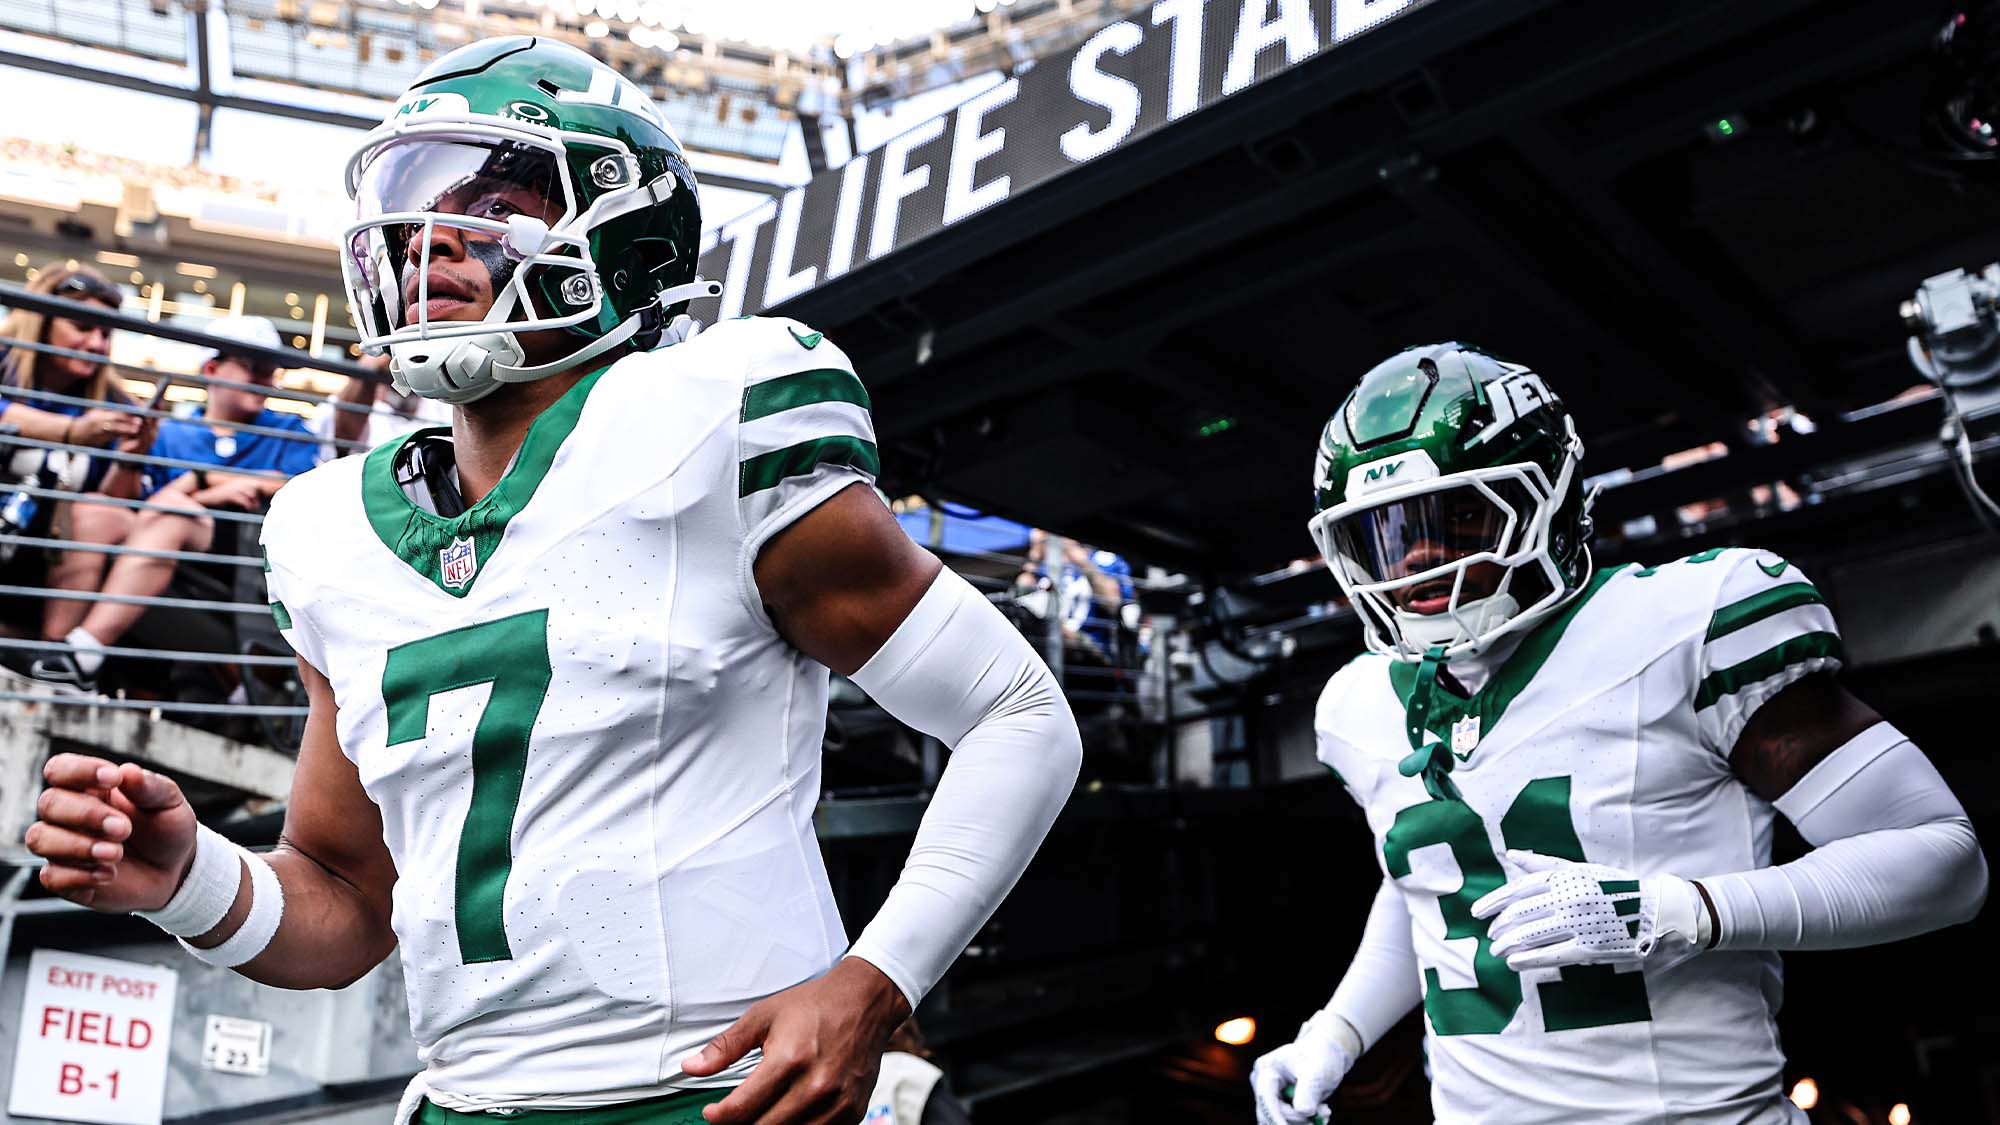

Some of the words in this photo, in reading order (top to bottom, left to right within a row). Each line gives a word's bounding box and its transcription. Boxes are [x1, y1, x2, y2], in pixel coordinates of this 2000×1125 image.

[394, 98, 439, 119] NY
[700, 76, 1019, 322] TLIFE
[1468, 372, 1560, 449] JET
[1364, 460, 1405, 484] NY
[447, 558, 471, 580] NFL
[382, 608, 552, 965] 7
[1384, 775, 1652, 1035] 31
[48, 967, 94, 988] EXIT
[103, 976, 158, 999] POST
[40, 1006, 153, 1050] FIELD
[58, 1063, 121, 1100] B-1
